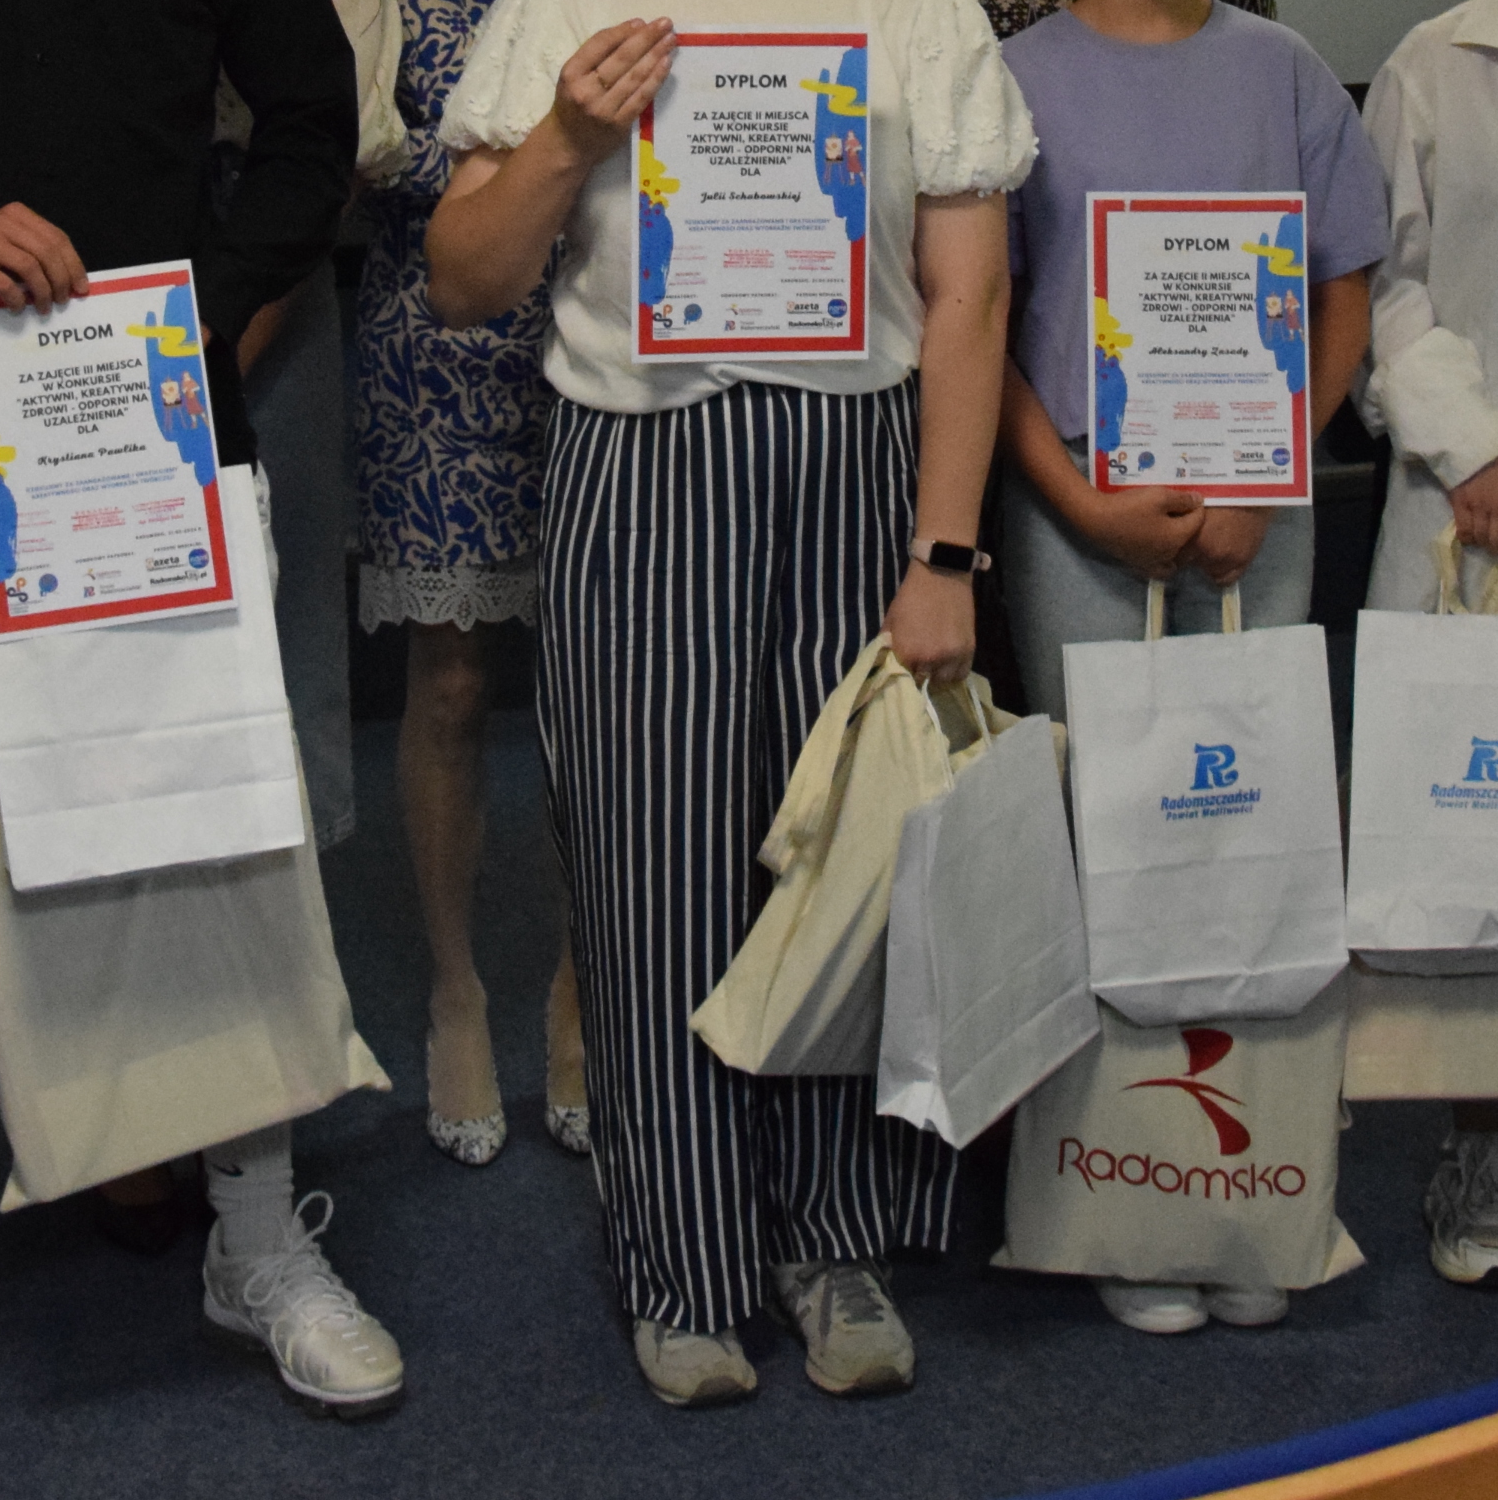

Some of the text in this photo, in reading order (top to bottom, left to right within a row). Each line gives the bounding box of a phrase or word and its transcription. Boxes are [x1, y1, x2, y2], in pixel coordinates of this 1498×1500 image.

[715, 75, 787, 88] DYPLOM
[694, 111, 809, 122] ZA ZAJĘCIE II MIEJSCA
[713, 123, 788, 131] W KONKURSIE
[691, 145, 811, 154] ZDROWI ODPORNI NA
[740, 168, 761, 176] DLA
[1164, 238, 1229, 251] DYPLOM
[1145, 273, 1158, 281] ZA
[1161, 272, 1198, 282] ZAJĘCIE
[1210, 272, 1250, 281] MIEJSCA
[1175, 283, 1232, 291] KONKURSIE
[1142, 304, 1253, 312] ZDROWI ODPORNI NA
[38, 323, 113, 347] DYPLOM
[1188, 325, 1207, 333] DLA
[19, 359, 143, 384] ZA ZAJĘCIE III MIEJSCA
[43, 373, 121, 391] W KONKURSIE
[22, 392, 148, 419] ZDROWI ODPORNI NA
[78, 423, 99, 435] DLA
[1160, 788, 1261, 811] Radomszczański
[1057, 1136, 1306, 1201] Radomsko
